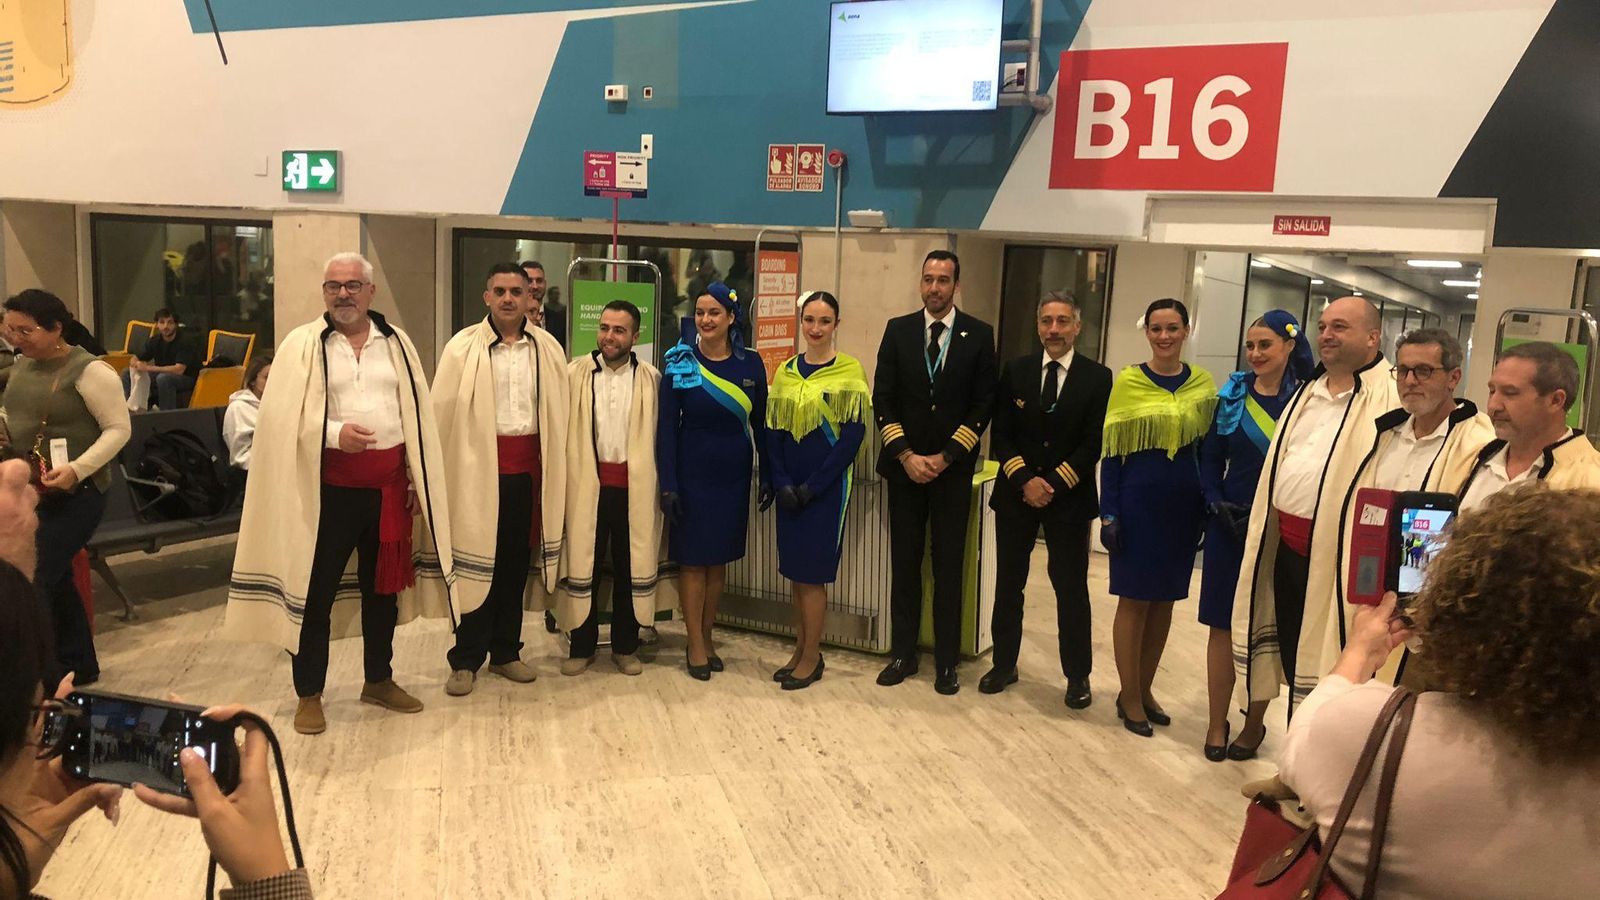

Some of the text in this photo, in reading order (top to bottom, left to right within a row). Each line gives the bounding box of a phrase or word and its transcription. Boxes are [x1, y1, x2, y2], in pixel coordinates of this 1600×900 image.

[1074, 75, 1251, 160] B16
[1277, 219, 1325, 232] SIN SALIDA
[761, 258, 786, 271] BOARDING
[758, 323, 787, 337] CABIN BAGS
